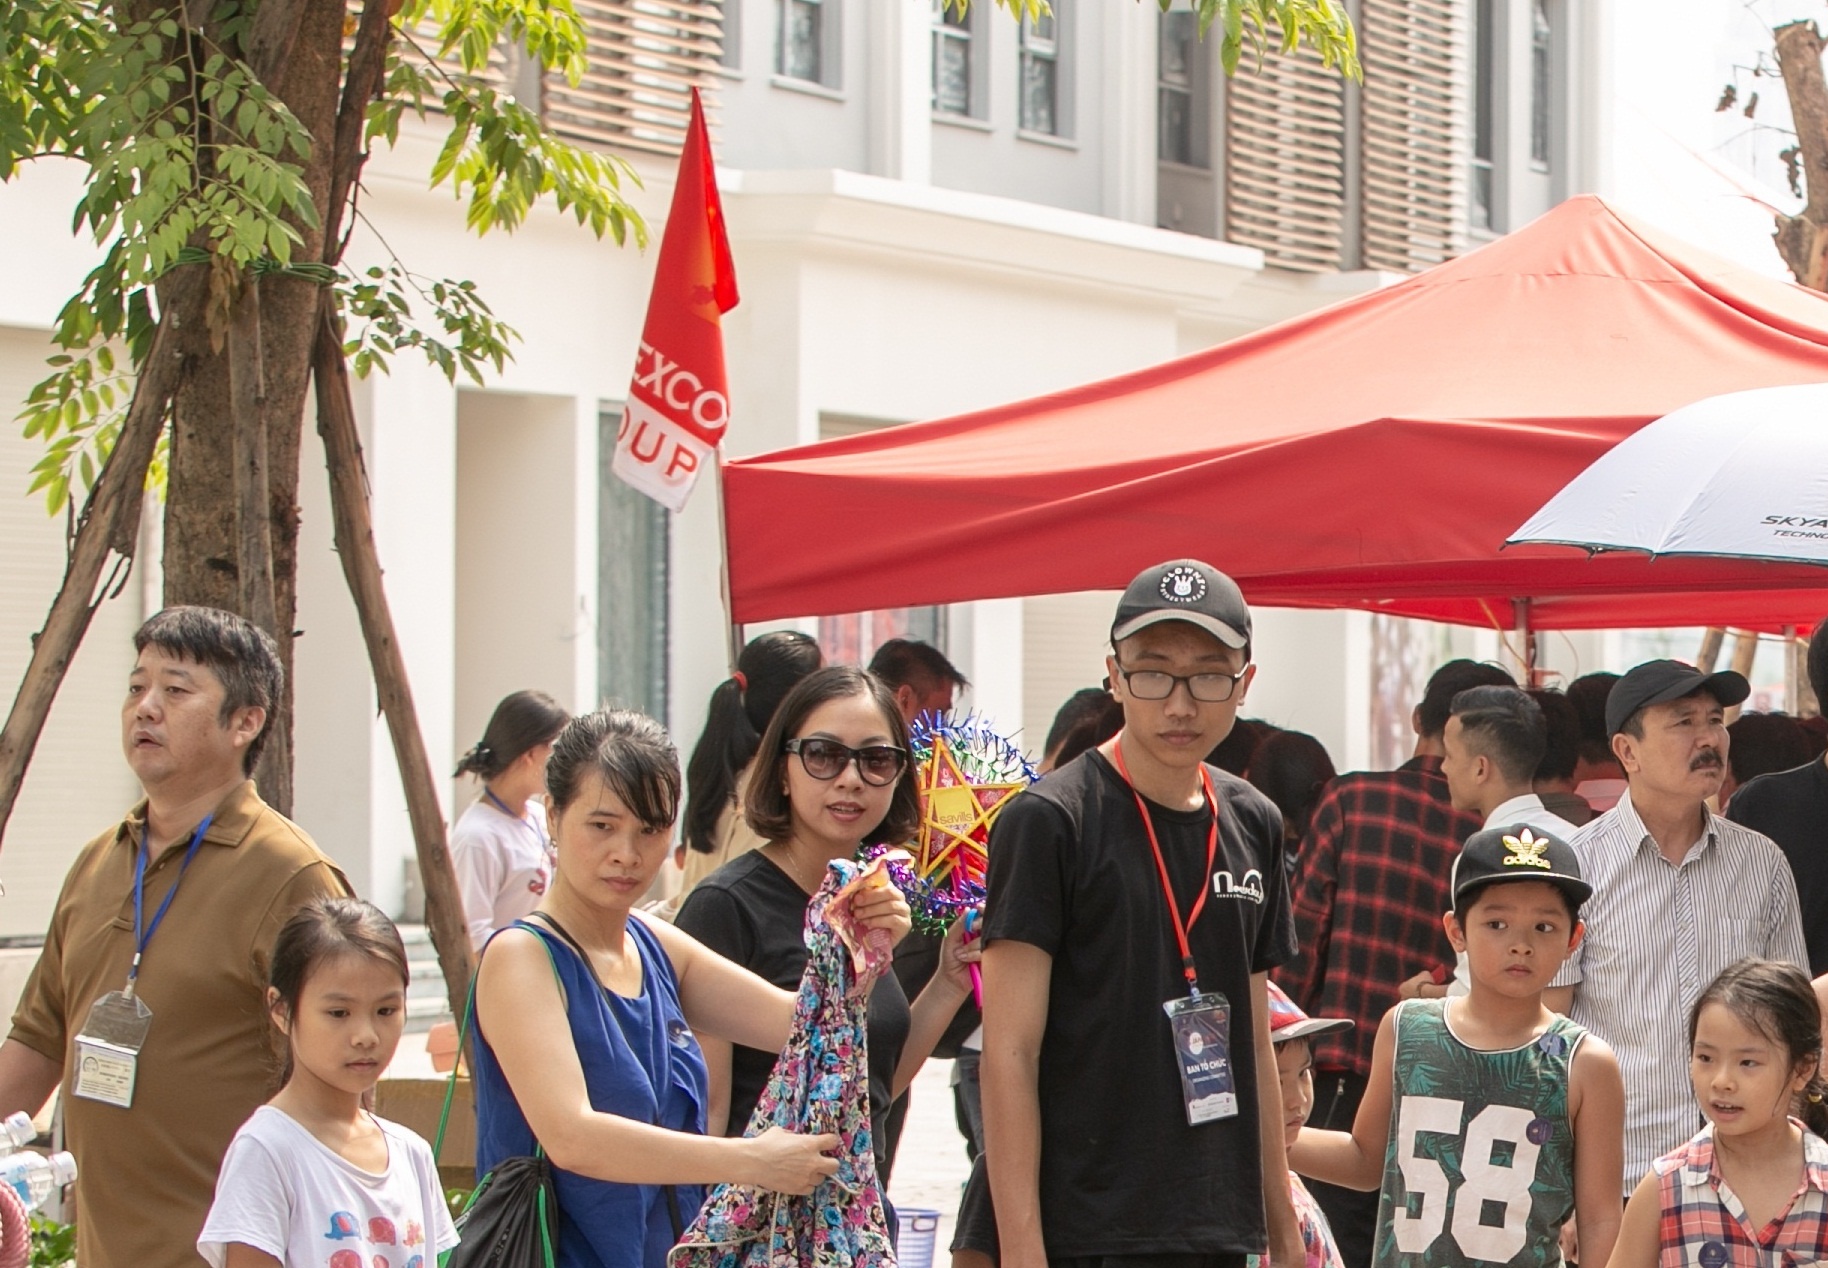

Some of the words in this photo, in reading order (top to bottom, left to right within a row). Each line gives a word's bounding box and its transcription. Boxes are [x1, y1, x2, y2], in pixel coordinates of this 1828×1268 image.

[940, 812, 973, 825] savills
[1503, 855, 1551, 869] adidas
[1187, 1064, 1200, 1075] BAN
[1394, 1096, 1541, 1264] 58
